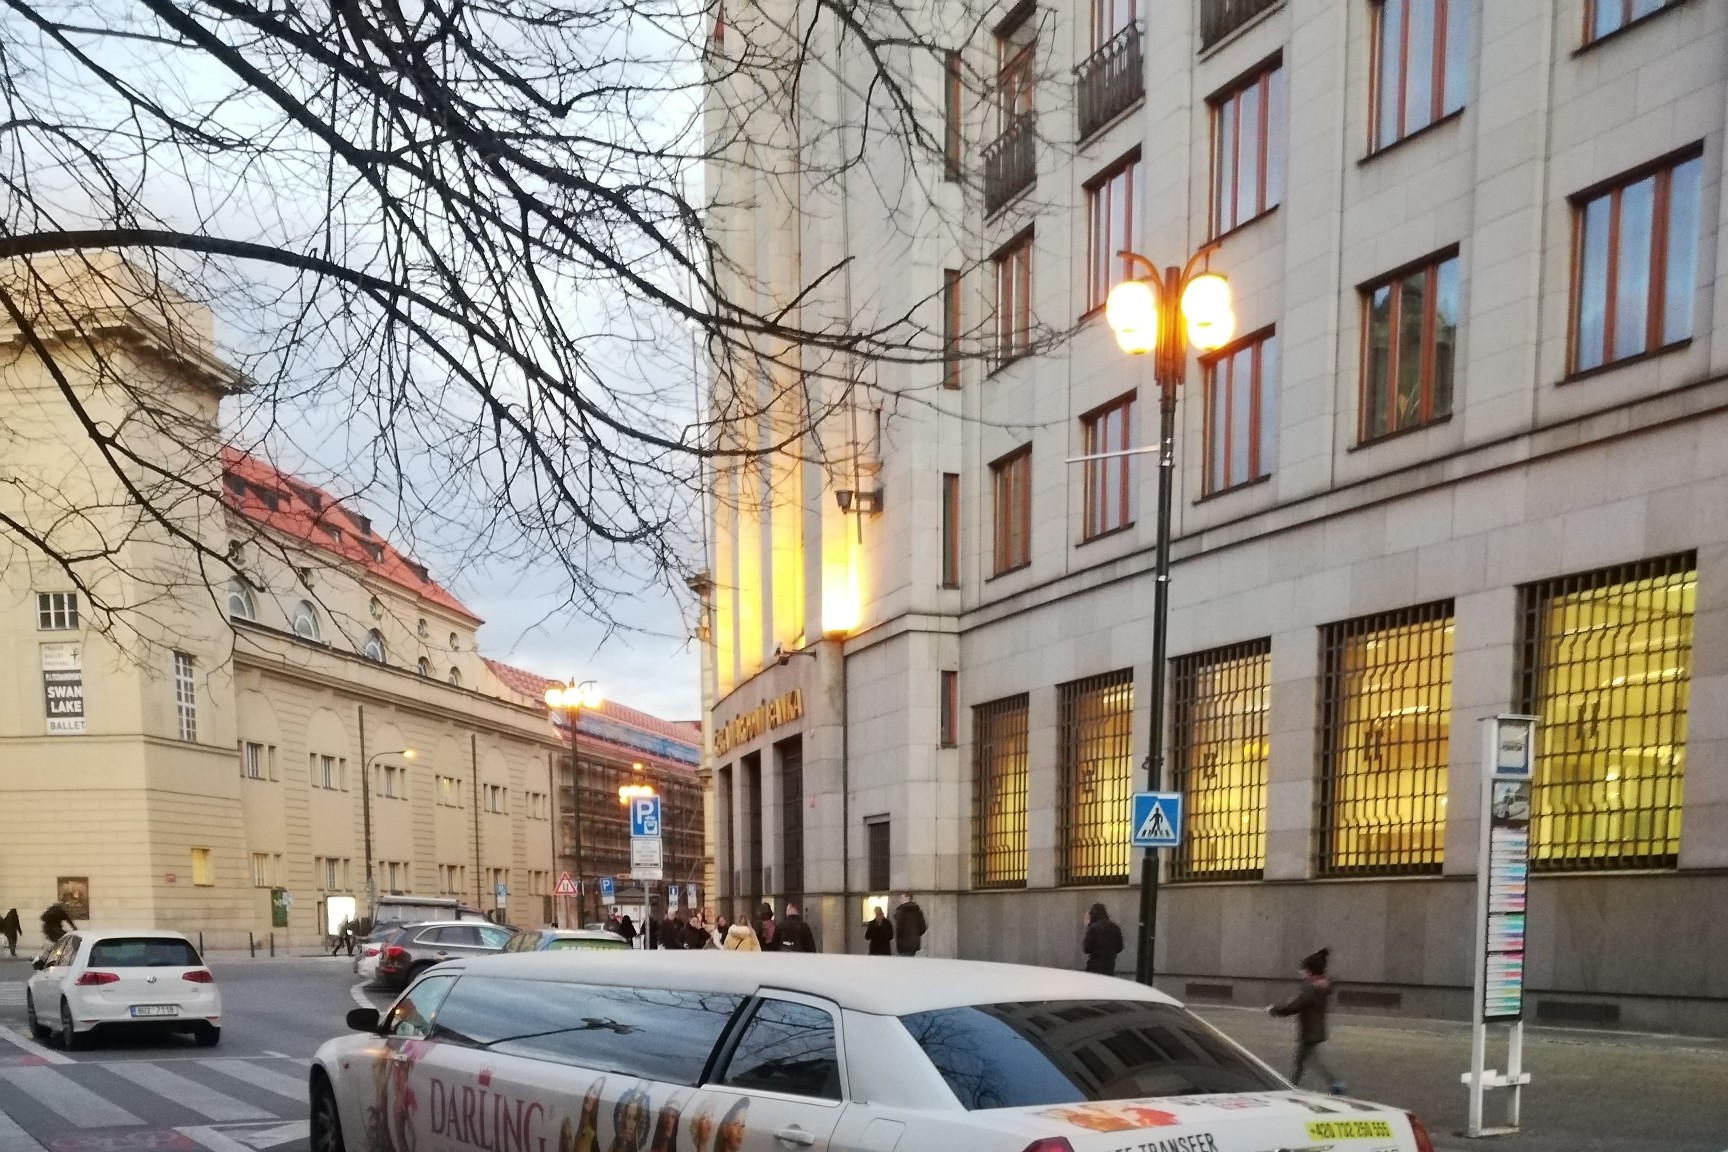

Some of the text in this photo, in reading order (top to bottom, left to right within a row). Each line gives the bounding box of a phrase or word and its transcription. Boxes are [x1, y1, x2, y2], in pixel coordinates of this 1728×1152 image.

[47, 685, 82, 698] SWAN
[50, 700, 82, 713] LAKE
[50, 721, 85, 731] BALLET
[636, 799, 654, 825] P
[1372, 1121, 1390, 1137] 555
